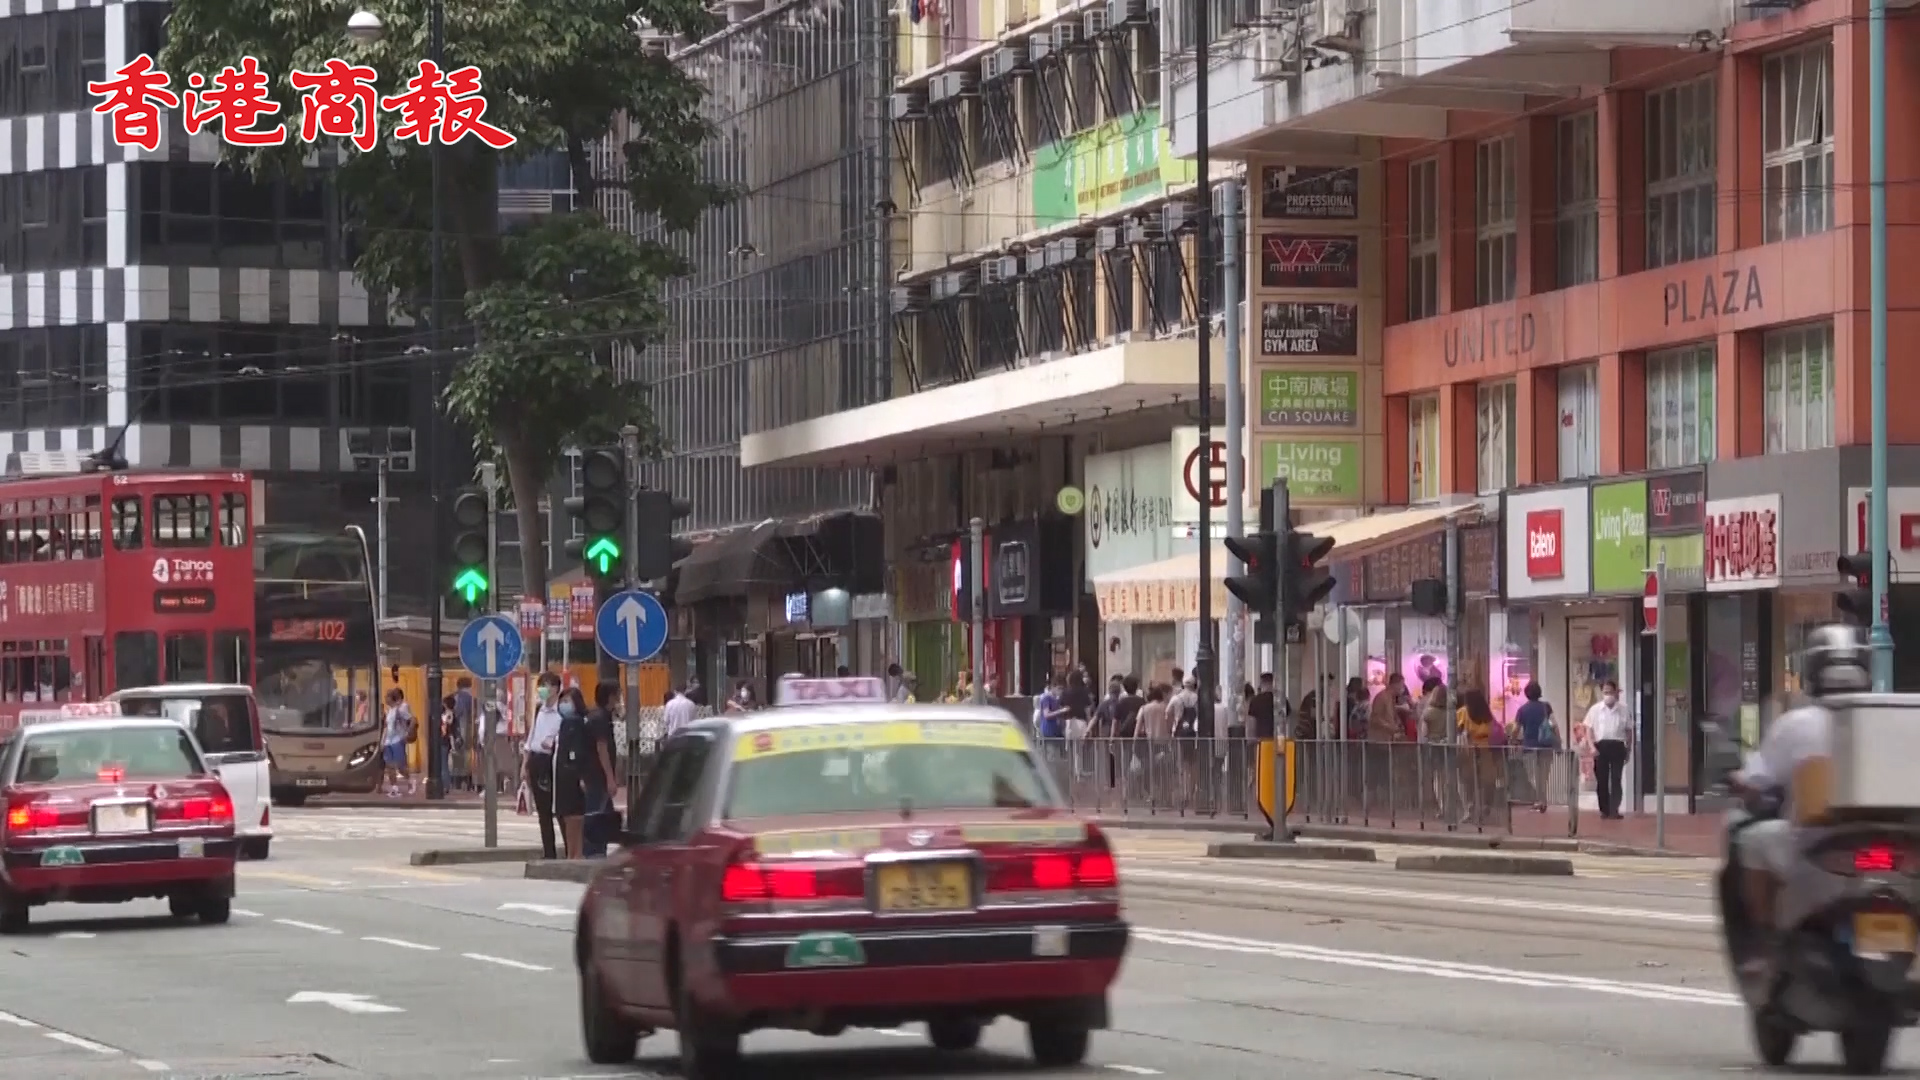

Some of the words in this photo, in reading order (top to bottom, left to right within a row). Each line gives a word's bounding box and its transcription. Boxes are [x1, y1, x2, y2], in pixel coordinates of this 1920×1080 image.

[1286, 195, 1352, 206] PROFESSIONAL
[1443, 313, 1536, 368] UNITED
[1664, 265, 1763, 326] PLAZA
[1264, 329, 1285, 338] FULLY
[1264, 340, 1288, 352] GYM
[1290, 340, 1319, 352] AREA
[1295, 411, 1349, 423] SQUARE
[1277, 443, 1342, 466] Living
[1277, 463, 1333, 481] Plaza
[1596, 511, 1621, 546] Living
[1623, 507, 1645, 537] Plaza
[1530, 526, 1556, 559] Baleno
[172, 559, 214, 570] Tahoe
[316, 620, 345, 640] 102
[791, 680, 872, 699] TAXI
